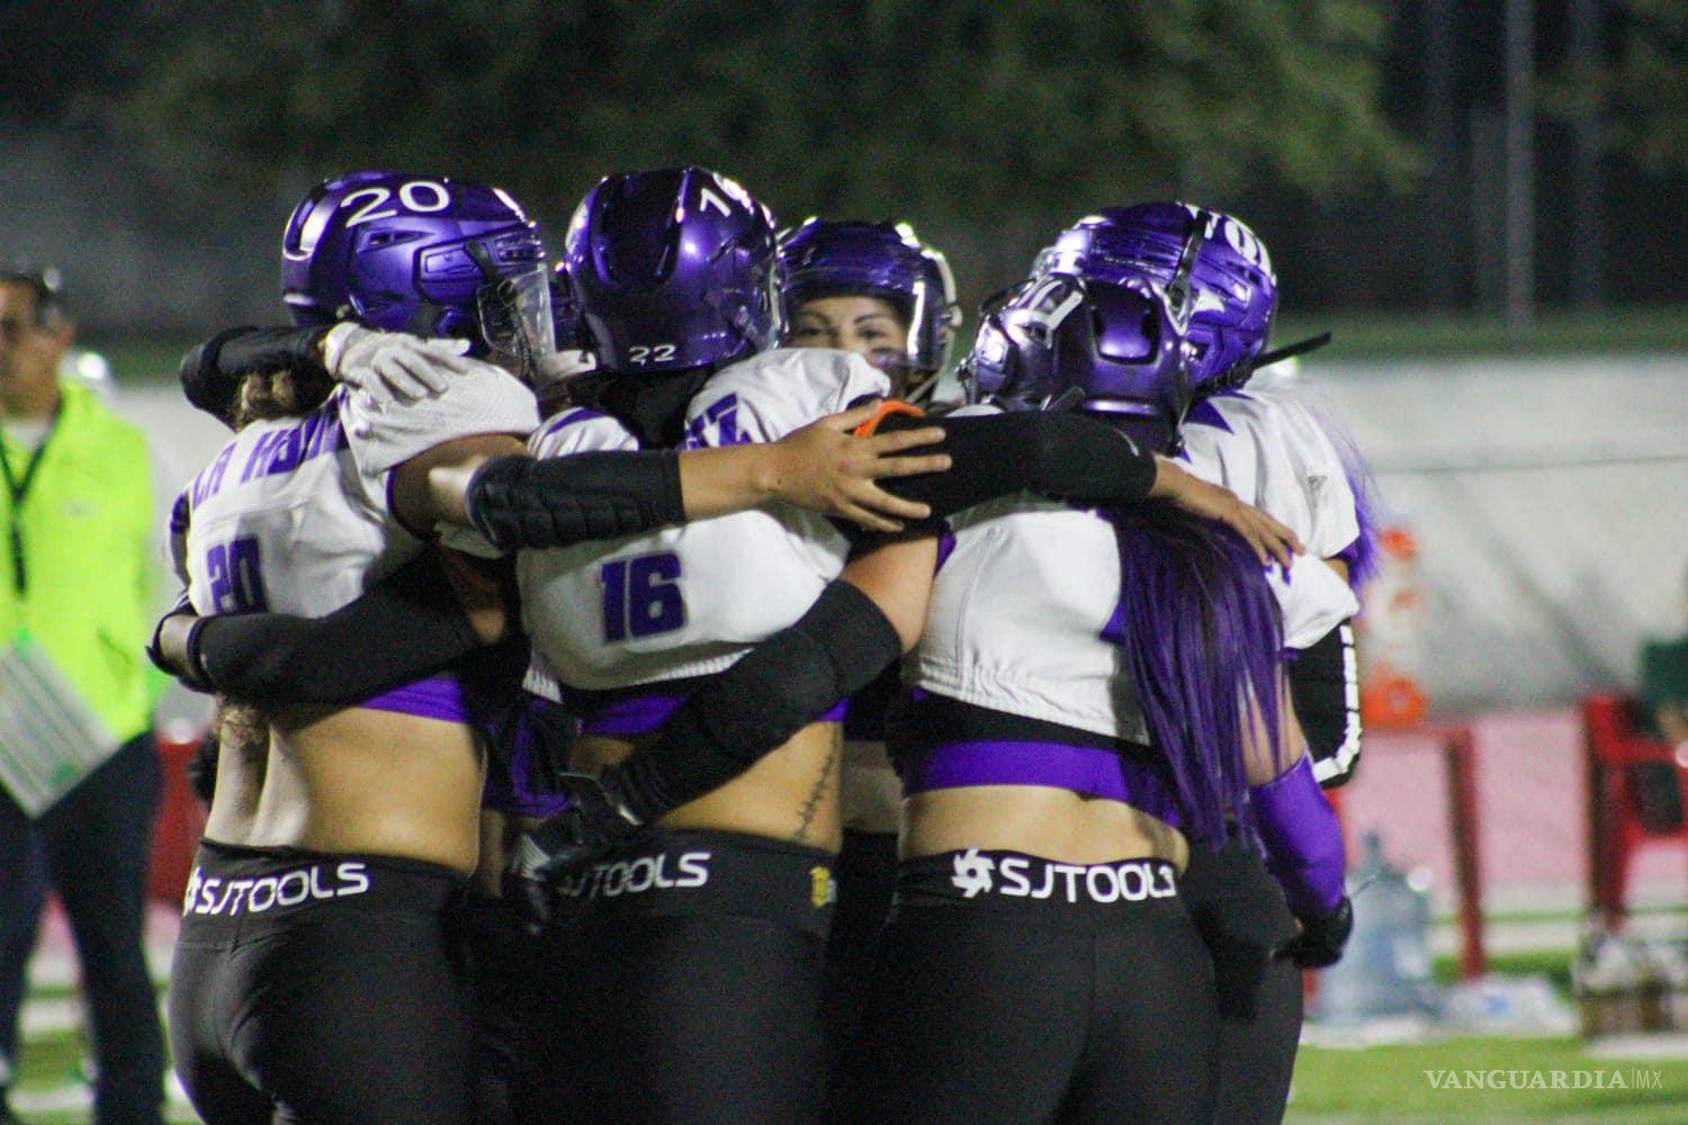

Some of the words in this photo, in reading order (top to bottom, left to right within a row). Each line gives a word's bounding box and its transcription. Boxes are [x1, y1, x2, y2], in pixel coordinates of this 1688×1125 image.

[340, 181, 450, 228] 20
[629, 345, 676, 367] 22
[207, 533, 270, 616] 20
[600, 551, 687, 644] 16
[195, 862, 369, 917] SJTOOLS
[1000, 858, 1177, 903] SJTOOLS
